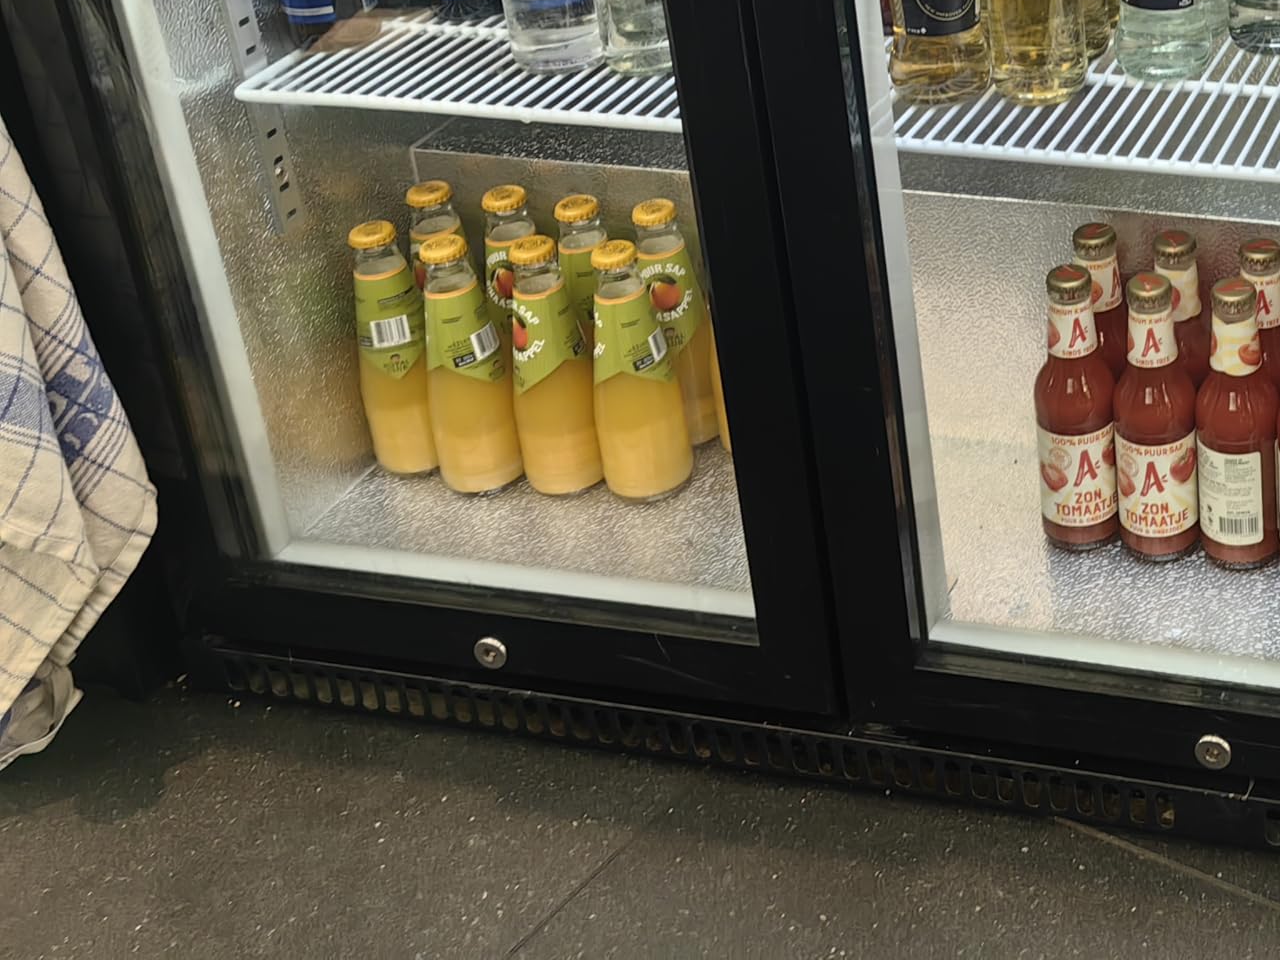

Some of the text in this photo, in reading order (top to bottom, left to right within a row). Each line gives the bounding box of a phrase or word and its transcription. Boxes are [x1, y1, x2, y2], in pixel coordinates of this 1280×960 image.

[665, 262, 687, 277] SAP
[1077, 434, 1100, 447] PUUR
[1144, 445, 1168, 456] PUUR
[1055, 491, 1118, 517] TOMAATJE
[1074, 488, 1103, 505] ZON
[1141, 502, 1170, 515] ZON
[1124, 507, 1189, 528] TOMAATJE
